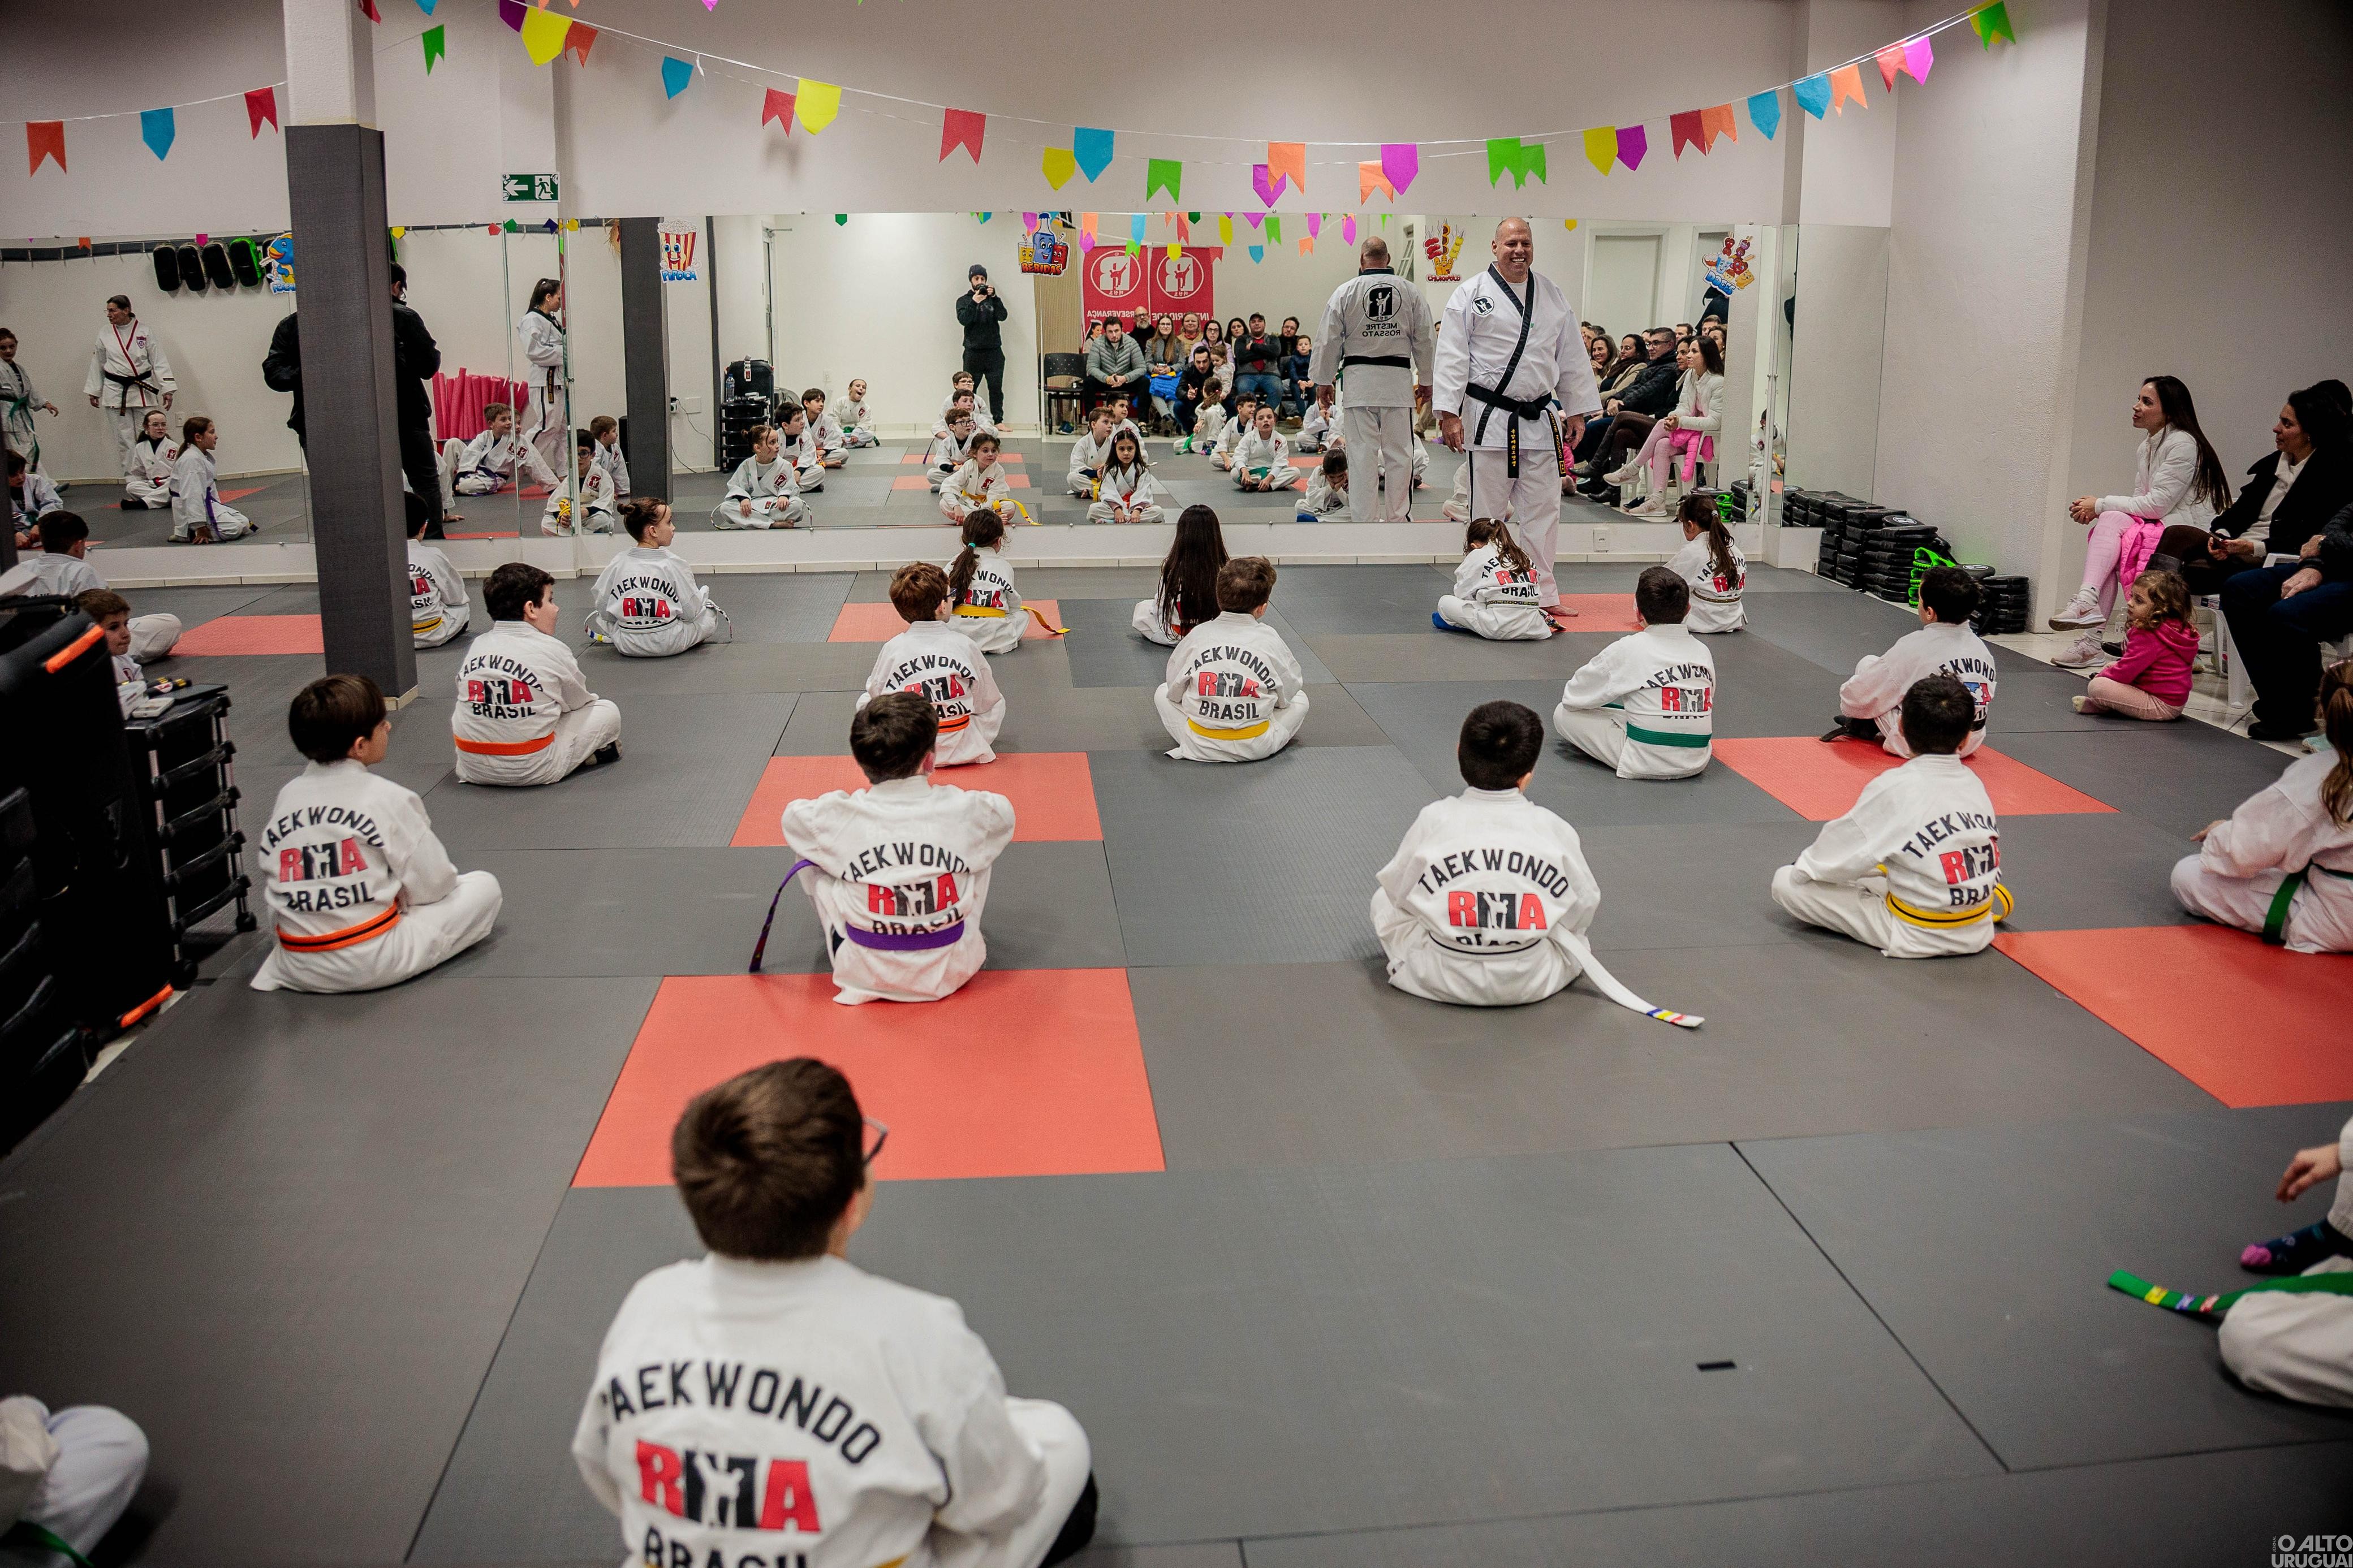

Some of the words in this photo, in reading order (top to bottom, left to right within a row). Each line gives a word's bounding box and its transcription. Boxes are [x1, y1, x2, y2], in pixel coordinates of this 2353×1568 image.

[662, 270, 697, 281] PIPOCA
[1022, 262, 1062, 275] BEBIDAS
[1705, 270, 1736, 295] DOCES
[610, 577, 679, 603] TAEKWONDO
[623, 598, 670, 617] RMA
[1184, 646, 1276, 690] TAEKWONDO
[1928, 658, 1996, 682] EKWOND
[468, 679, 534, 705] RMA
[1198, 671, 1260, 698] RMA
[472, 703, 536, 719] BRASIL
[936, 701, 971, 719] ASIL
[1199, 701, 1260, 720] BRASIL
[1661, 687, 1712, 712] RMA
[279, 837, 368, 883] RMA
[1418, 849, 1568, 898] TAEKWONDO
[282, 882, 375, 912] BRASIL
[868, 873, 960, 916] RMA
[1448, 889, 1548, 930] RMA
[601, 1360, 881, 1465] AEKWONDO
[636, 1439, 821, 1533] RMA
